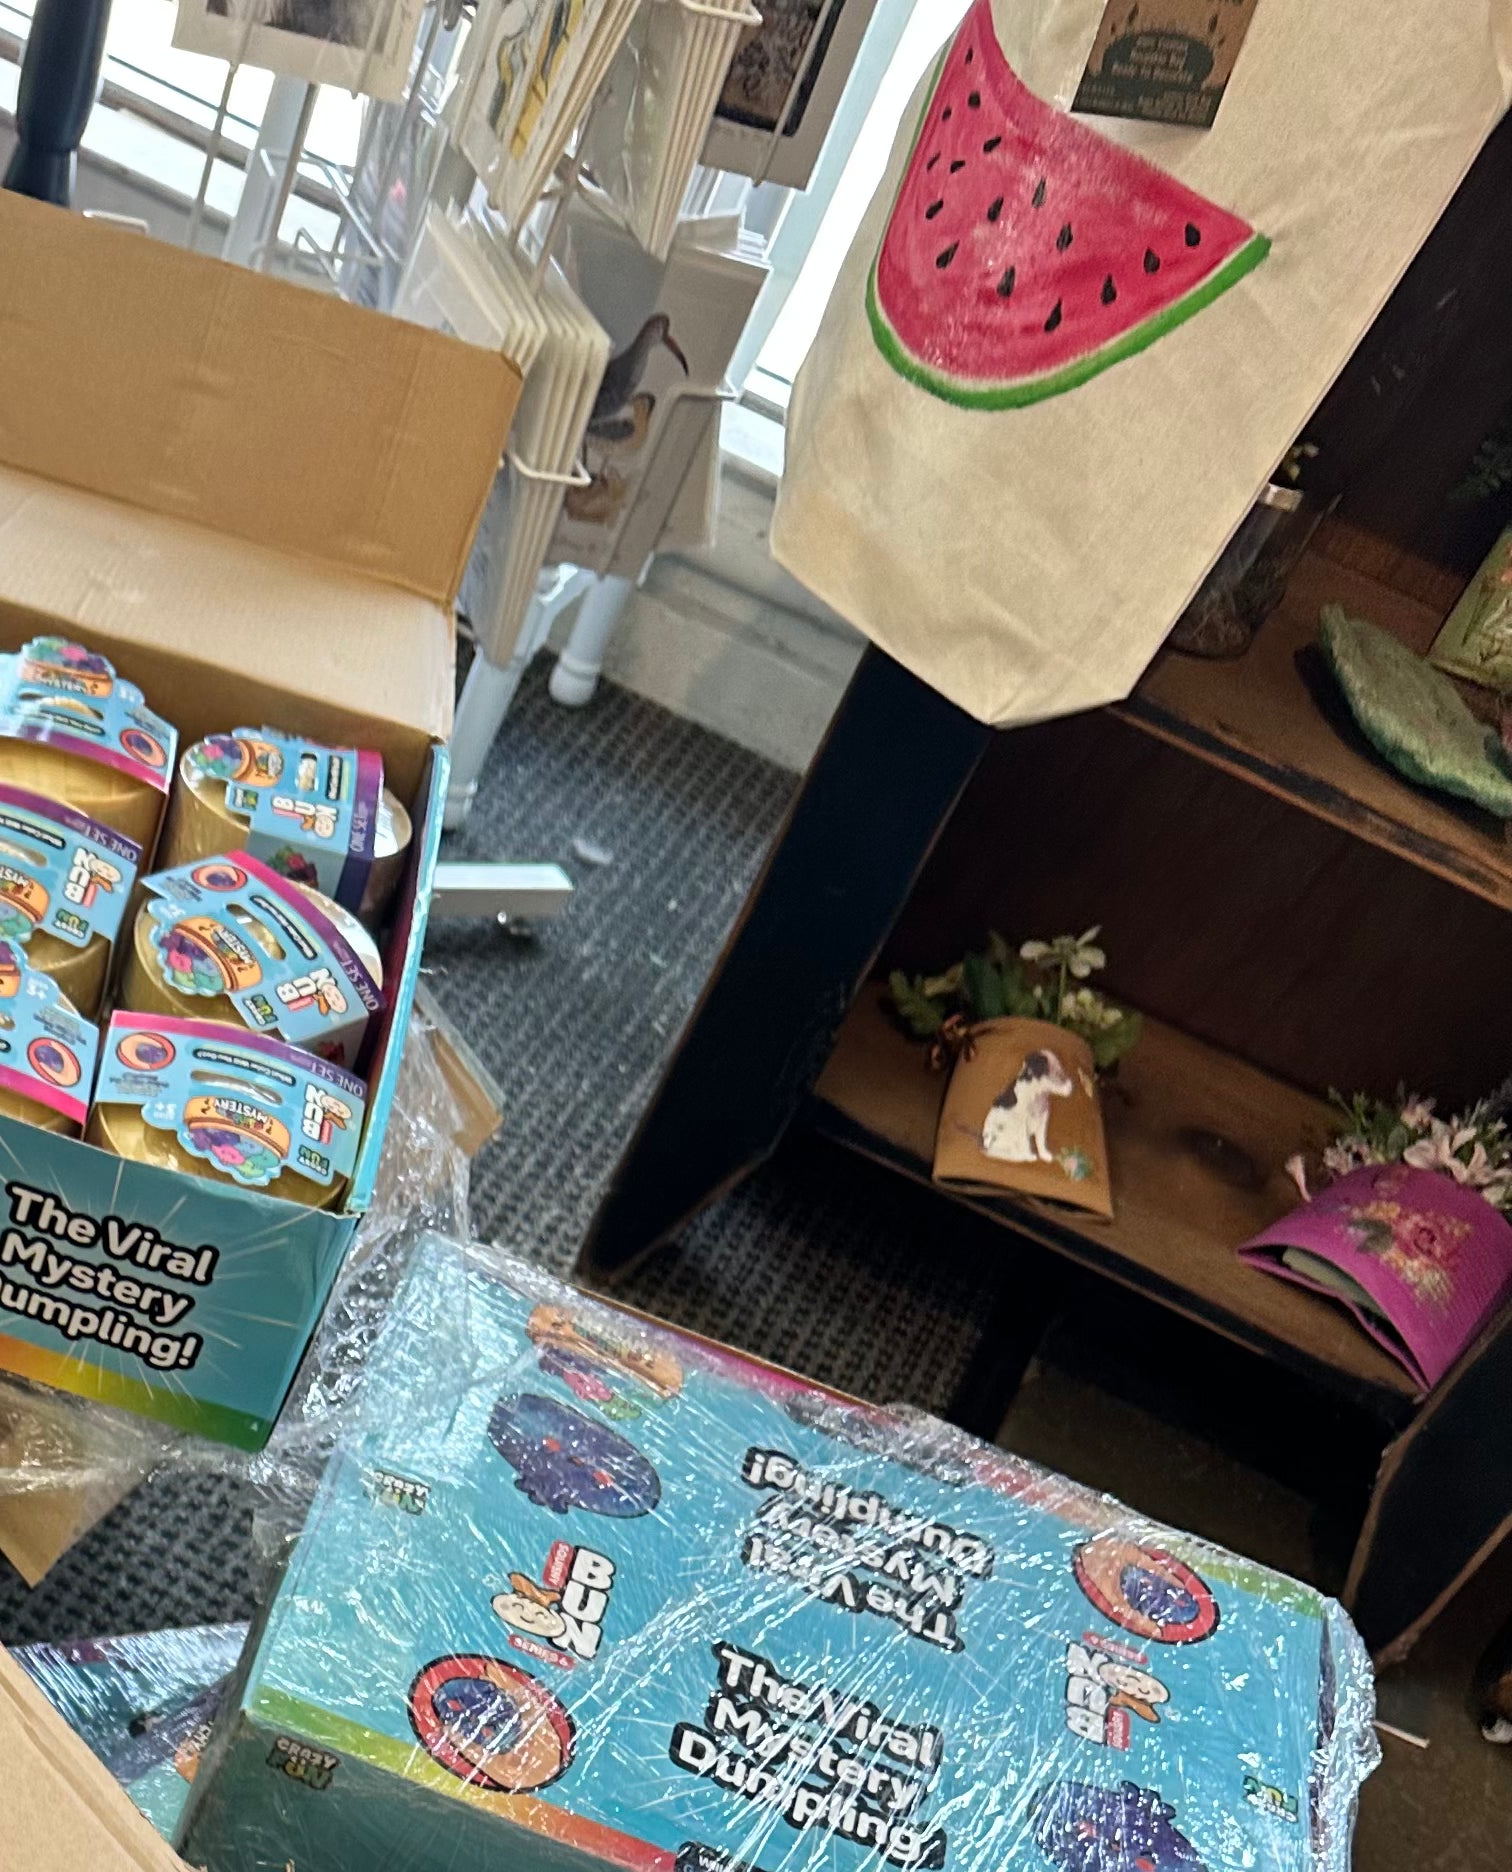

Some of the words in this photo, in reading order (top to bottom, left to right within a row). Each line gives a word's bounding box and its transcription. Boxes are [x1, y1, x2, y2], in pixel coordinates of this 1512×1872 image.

[272, 797, 338, 820] BUN
[63, 848, 98, 905] BUN
[276, 967, 338, 1003] BUN
[341, 959, 362, 983] SET
[356, 984, 379, 1011] ONE
[310, 1061, 334, 1082] SET
[338, 1075, 365, 1097] ONE
[214, 1098, 269, 1123] MYSTERY
[303, 1083, 325, 1141] BUN
[11, 1186, 97, 1243] The
[107, 1220, 213, 1283] Viral
[0, 1232, 189, 1323] Mystery
[372, 1470, 431, 1497] CRAZY
[550, 1543, 570, 1584] SQUISHY
[551, 1546, 616, 1660] BUN
[868, 1587, 961, 1650] The
[721, 1648, 810, 1712] The
[822, 1692, 935, 1767] Viral
[267, 1751, 335, 1791] FUN
[275, 1736, 339, 1770] CRAZY
[679, 1730, 929, 1862] Dumpling
